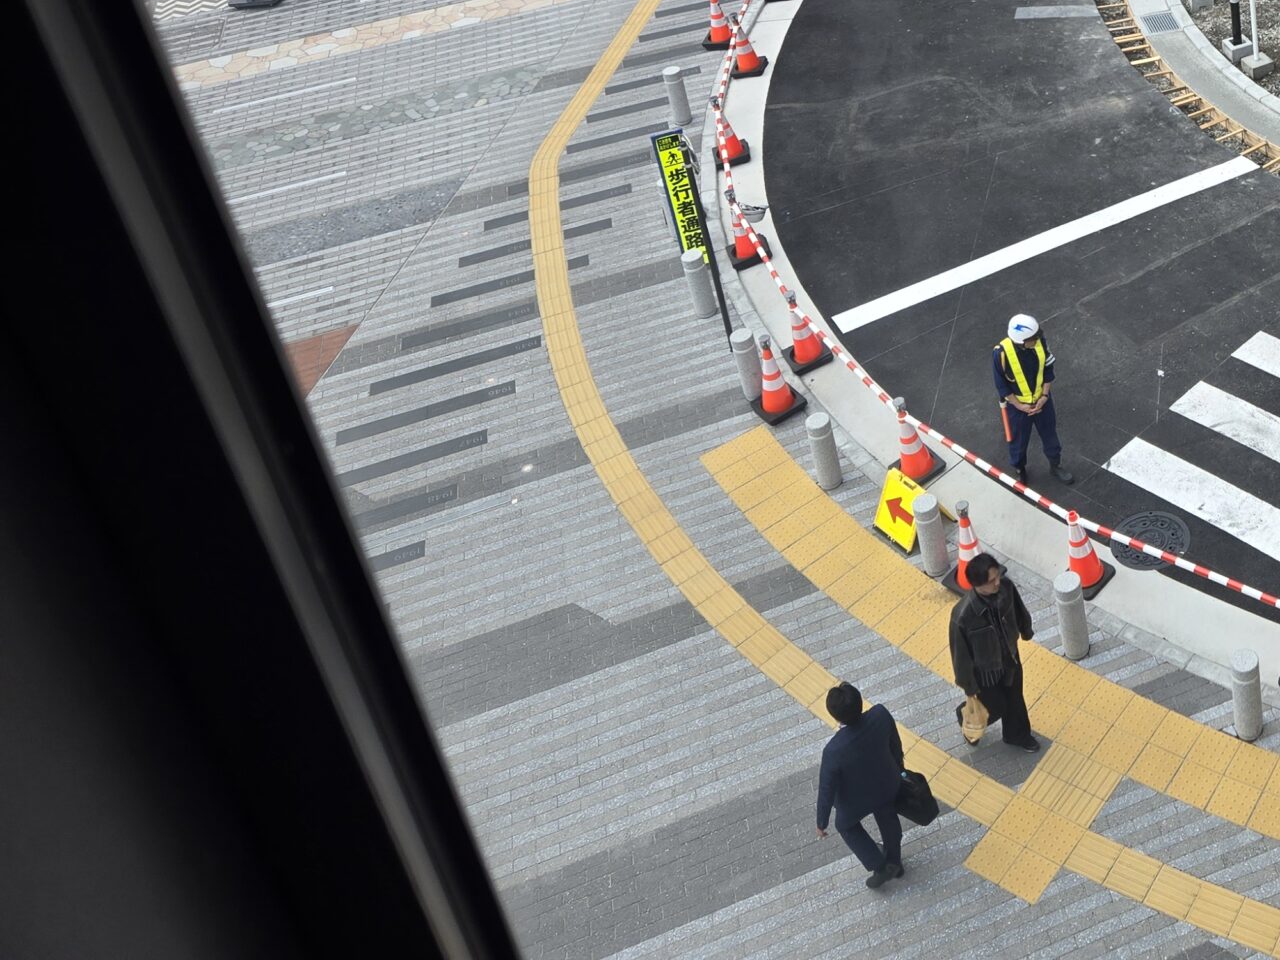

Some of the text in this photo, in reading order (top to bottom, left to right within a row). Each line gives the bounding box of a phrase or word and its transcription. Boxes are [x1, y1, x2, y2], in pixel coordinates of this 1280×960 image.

[668, 167, 705, 250] 歩行者通路
